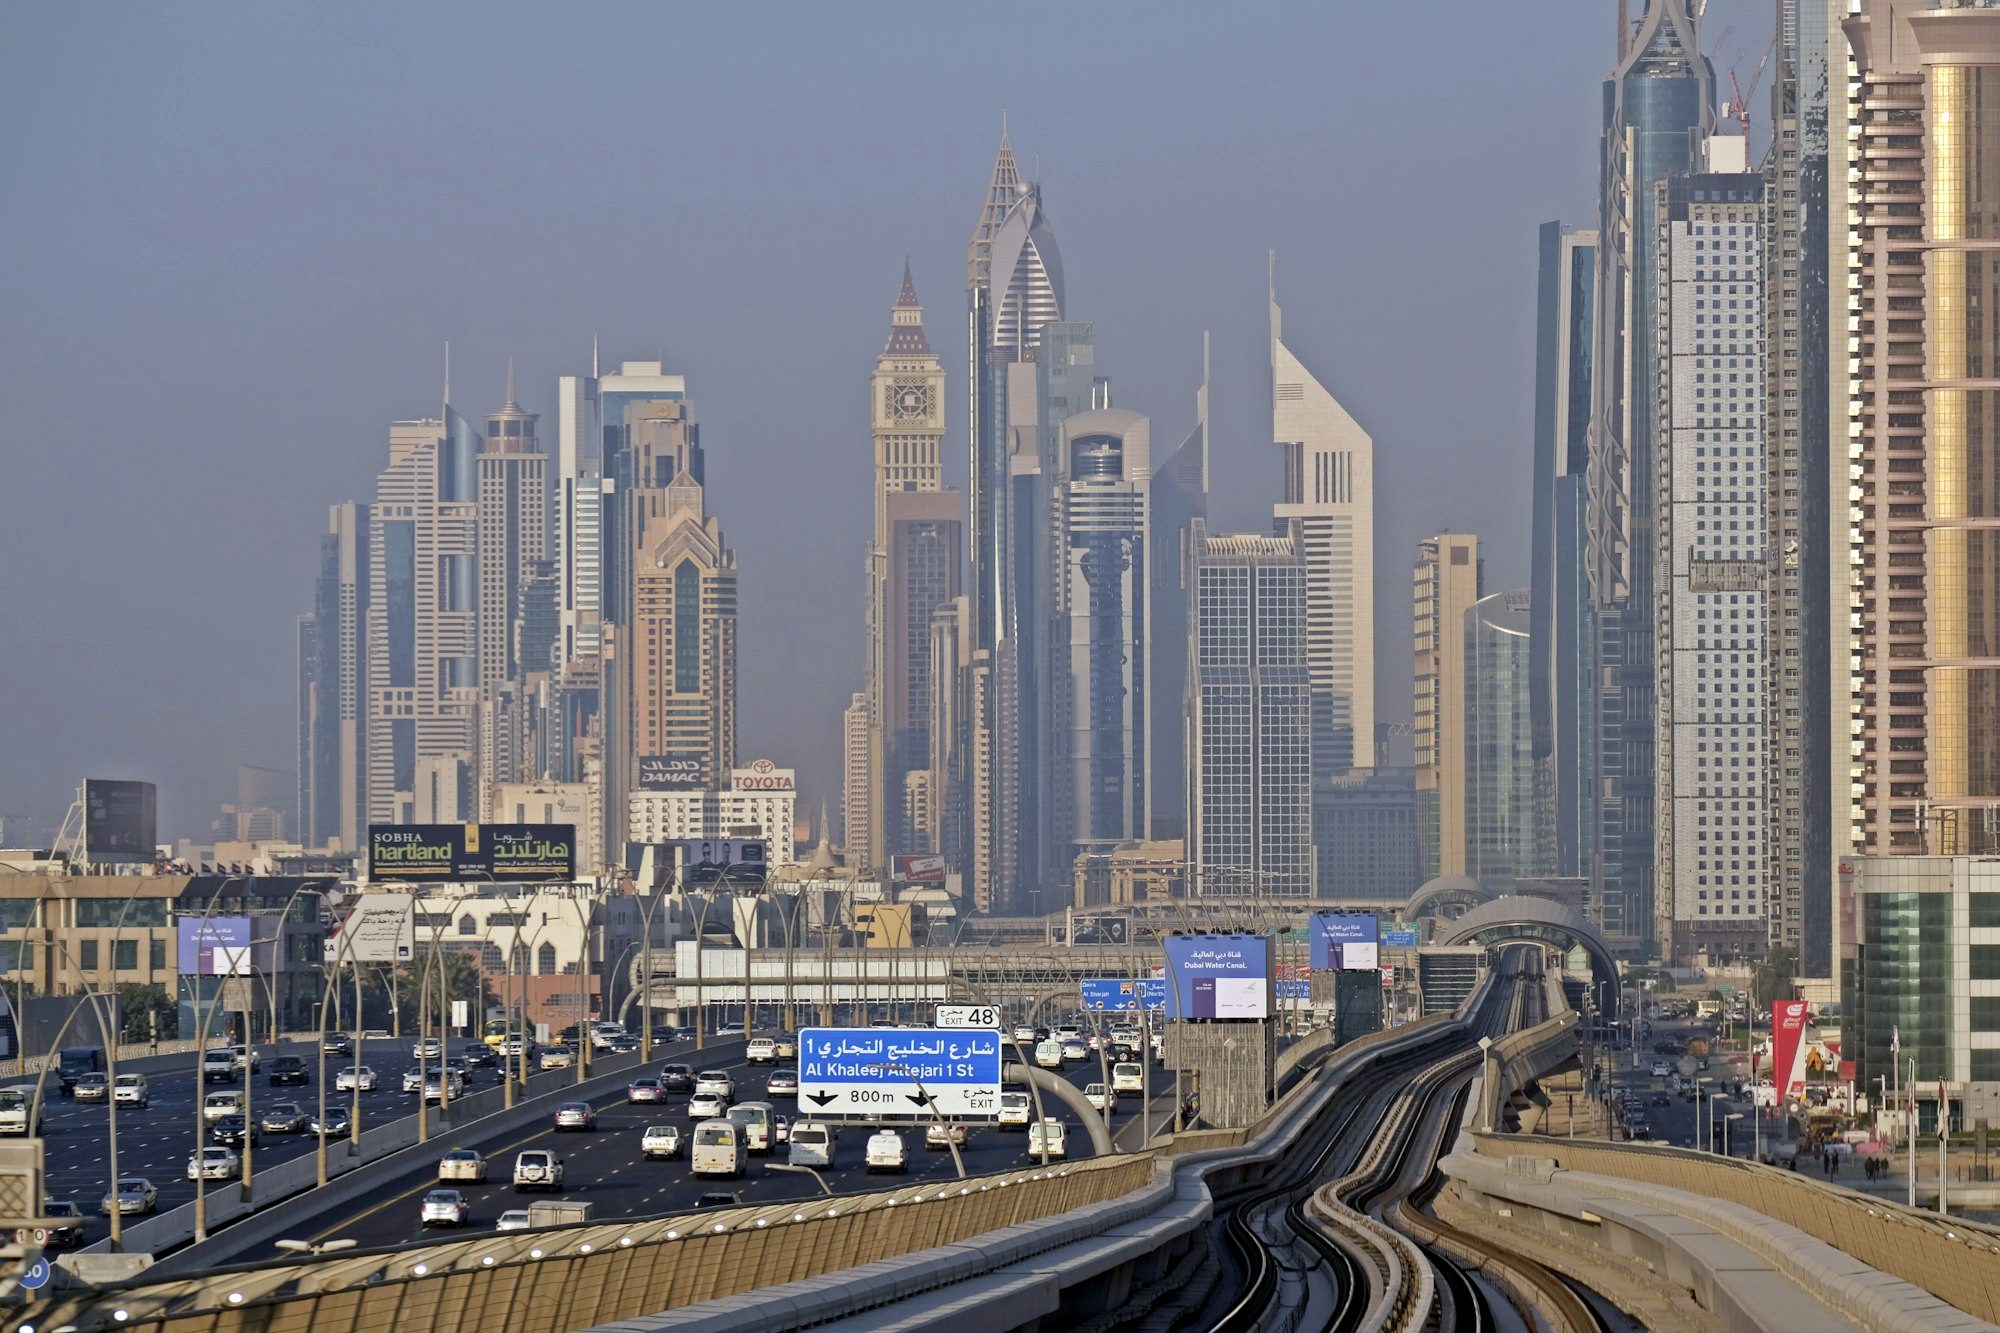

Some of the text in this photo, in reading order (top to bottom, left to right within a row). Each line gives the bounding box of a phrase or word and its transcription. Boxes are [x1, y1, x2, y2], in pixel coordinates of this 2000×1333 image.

[641, 772, 700, 783] DAMAC
[733, 777, 793, 788] TOYOTA
[374, 833, 422, 843] SOBHA
[374, 842, 452, 860] hartland
[494, 840, 569, 861] هارتلاند
[1184, 961, 1204, 969] Dubai
[1205, 961, 1225, 969] Water
[940, 1009, 963, 1018] مخرج
[968, 1009, 994, 1025] 48
[807, 1039, 995, 1060] شارع الخليج التجاري 1
[805, 1063, 822, 1077] Al
[827, 1063, 884, 1078] Khaleej
[946, 1063, 952, 1077] 1
[956, 1063, 974, 1077] St
[963, 1088, 994, 1099] مخرج
[970, 1099, 994, 1109] EXIT
[18, 1230, 44, 1242] 10
